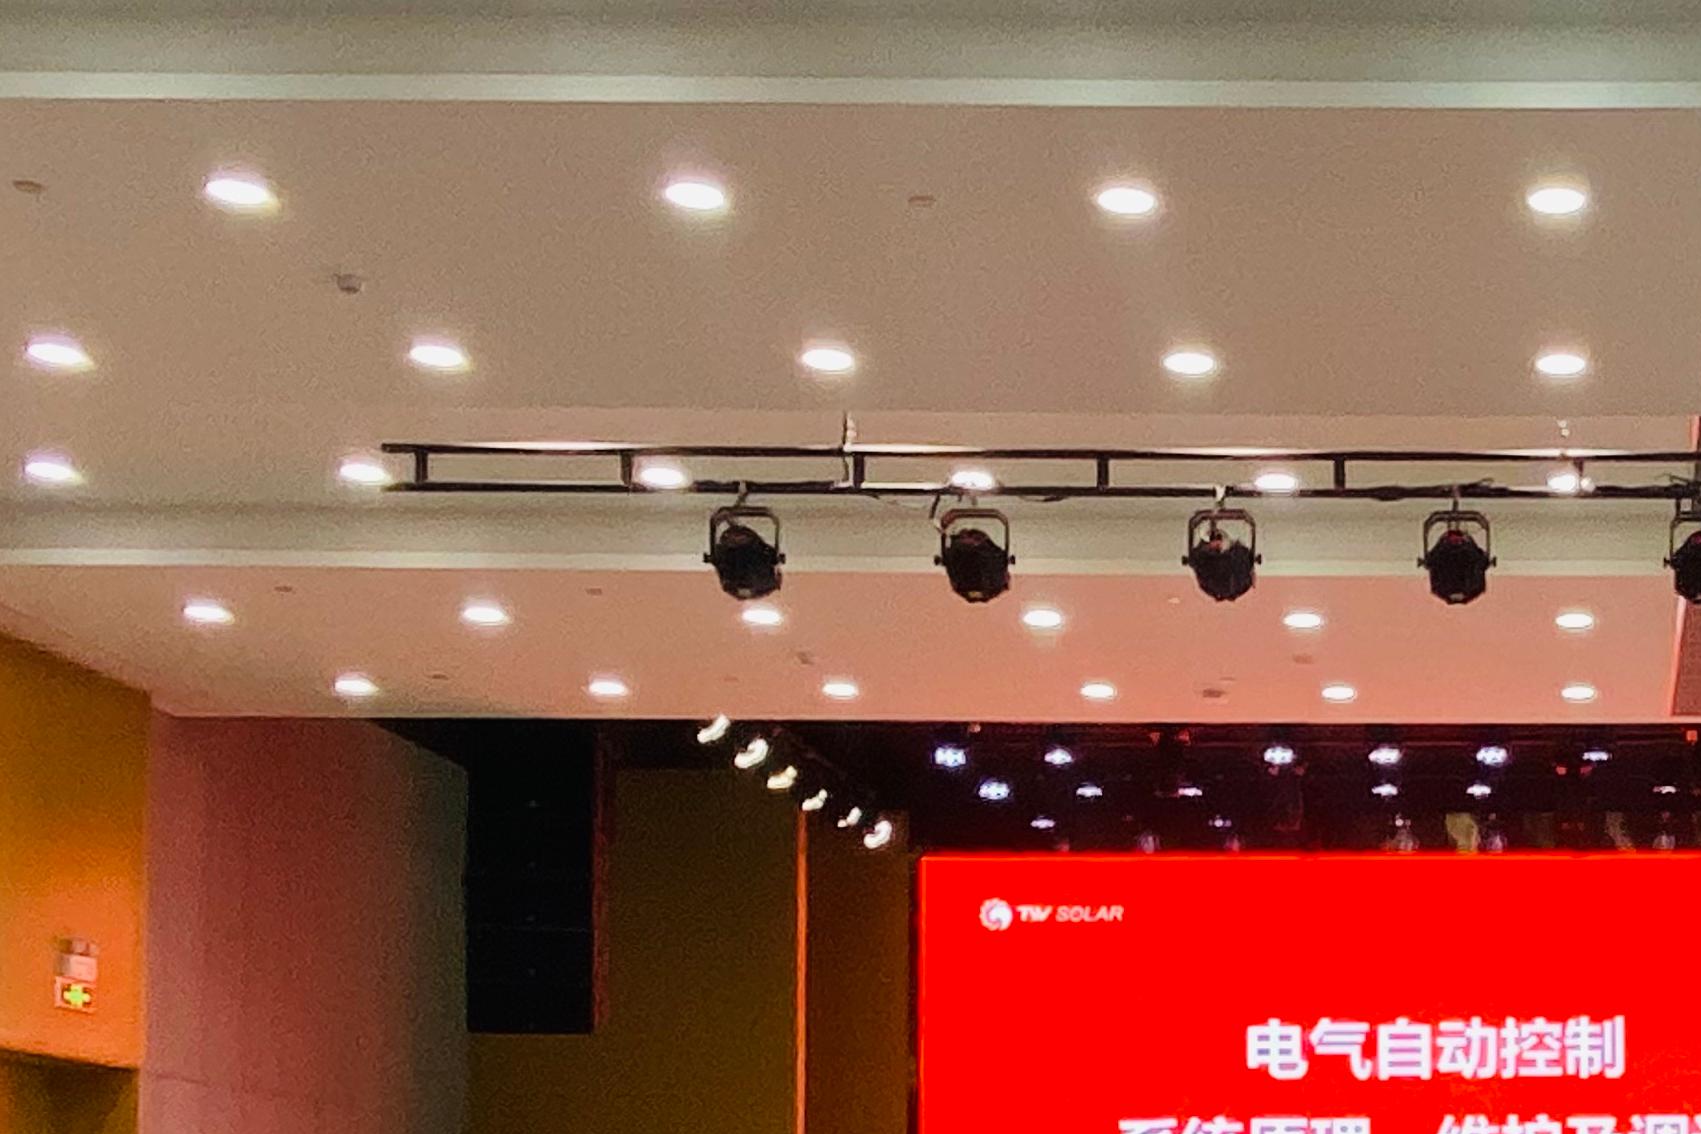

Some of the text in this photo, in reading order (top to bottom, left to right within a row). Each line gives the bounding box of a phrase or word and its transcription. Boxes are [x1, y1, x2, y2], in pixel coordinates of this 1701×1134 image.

[1055, 904, 1125, 923] SOLAR
[1246, 1015, 1627, 1081] 电气自动控制
